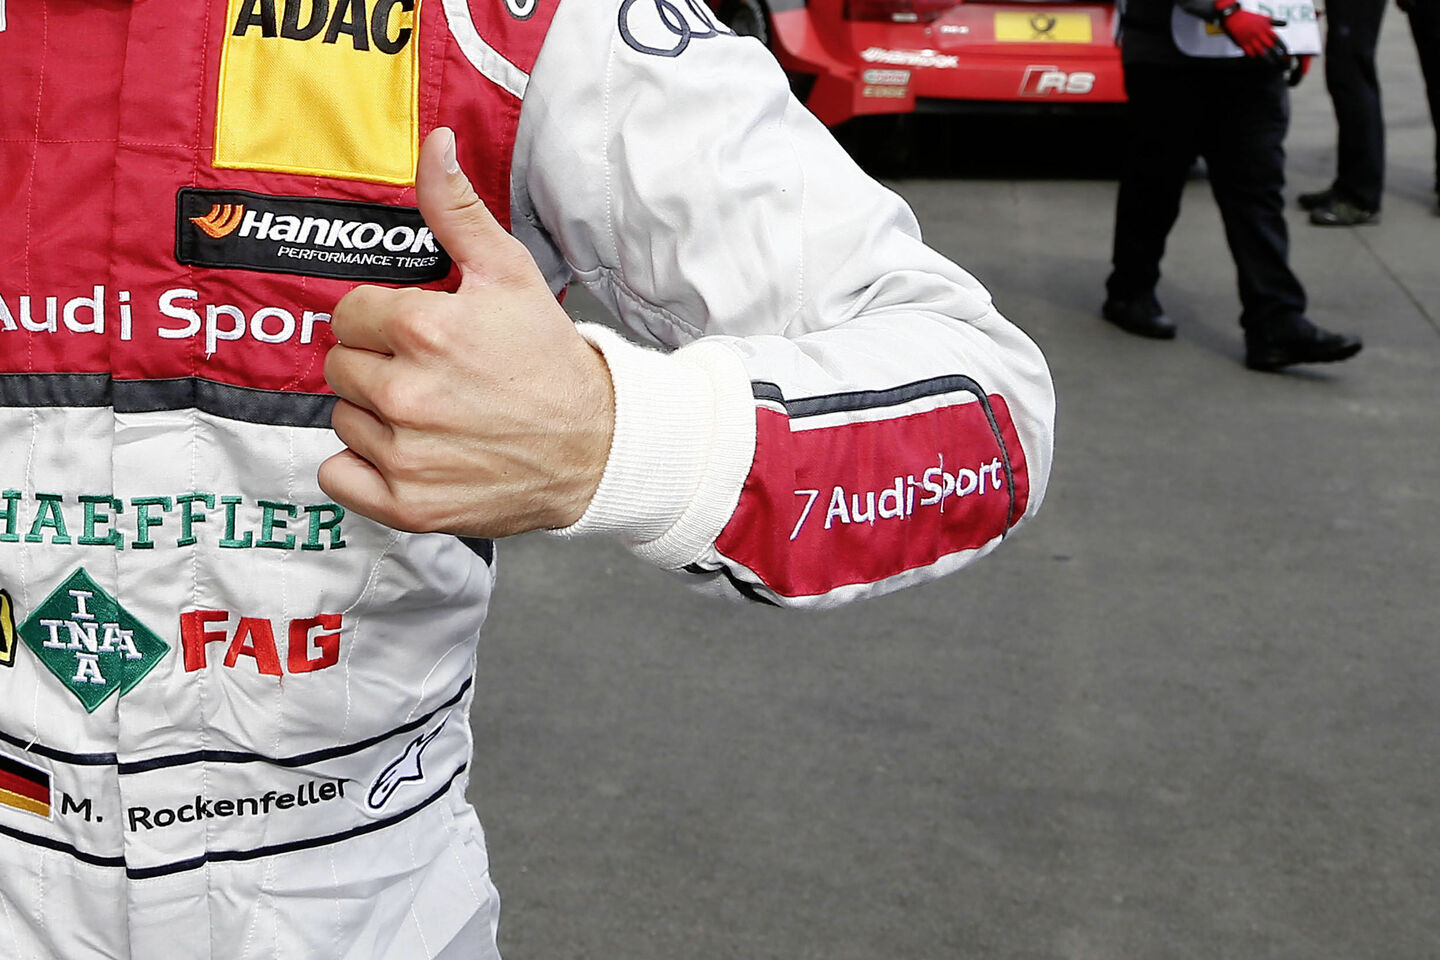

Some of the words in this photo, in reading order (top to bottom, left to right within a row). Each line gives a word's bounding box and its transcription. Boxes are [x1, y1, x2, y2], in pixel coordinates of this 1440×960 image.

[1037, 72, 1096, 93] RS
[238, 210, 440, 254] Hankook
[278, 246, 393, 268] PERFORMANCE
[396, 255, 439, 268] TIRES
[158, 287, 332, 356] Spor
[179, 609, 343, 677] FAG
[61, 791, 104, 822] M.
[127, 778, 350, 833] Rockenfeller
